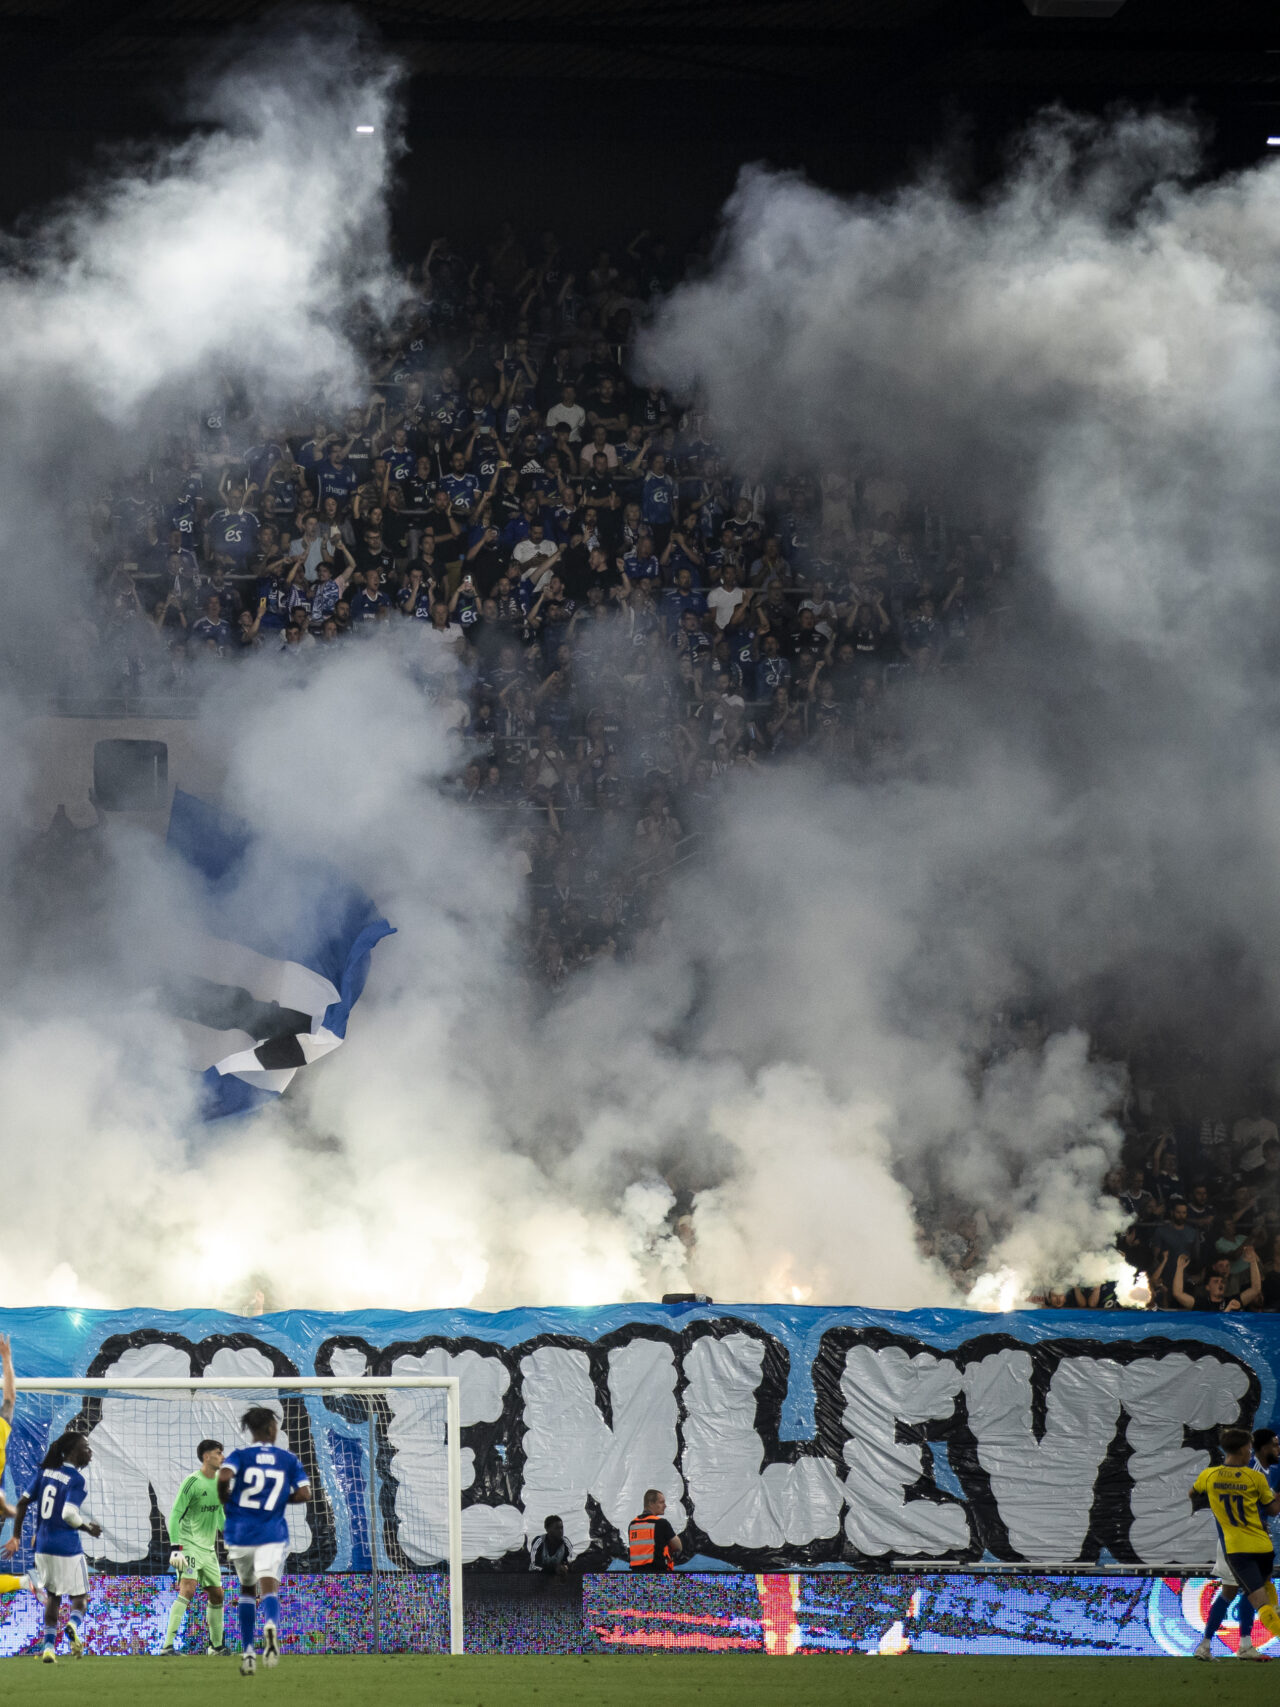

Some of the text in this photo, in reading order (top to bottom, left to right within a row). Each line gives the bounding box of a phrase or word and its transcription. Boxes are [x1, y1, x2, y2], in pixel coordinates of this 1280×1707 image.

[520, 466, 545, 474] adidas
[41, 1484, 57, 1519] 6
[239, 1466, 285, 1511] 27
[1219, 1493, 1249, 1527] 11
